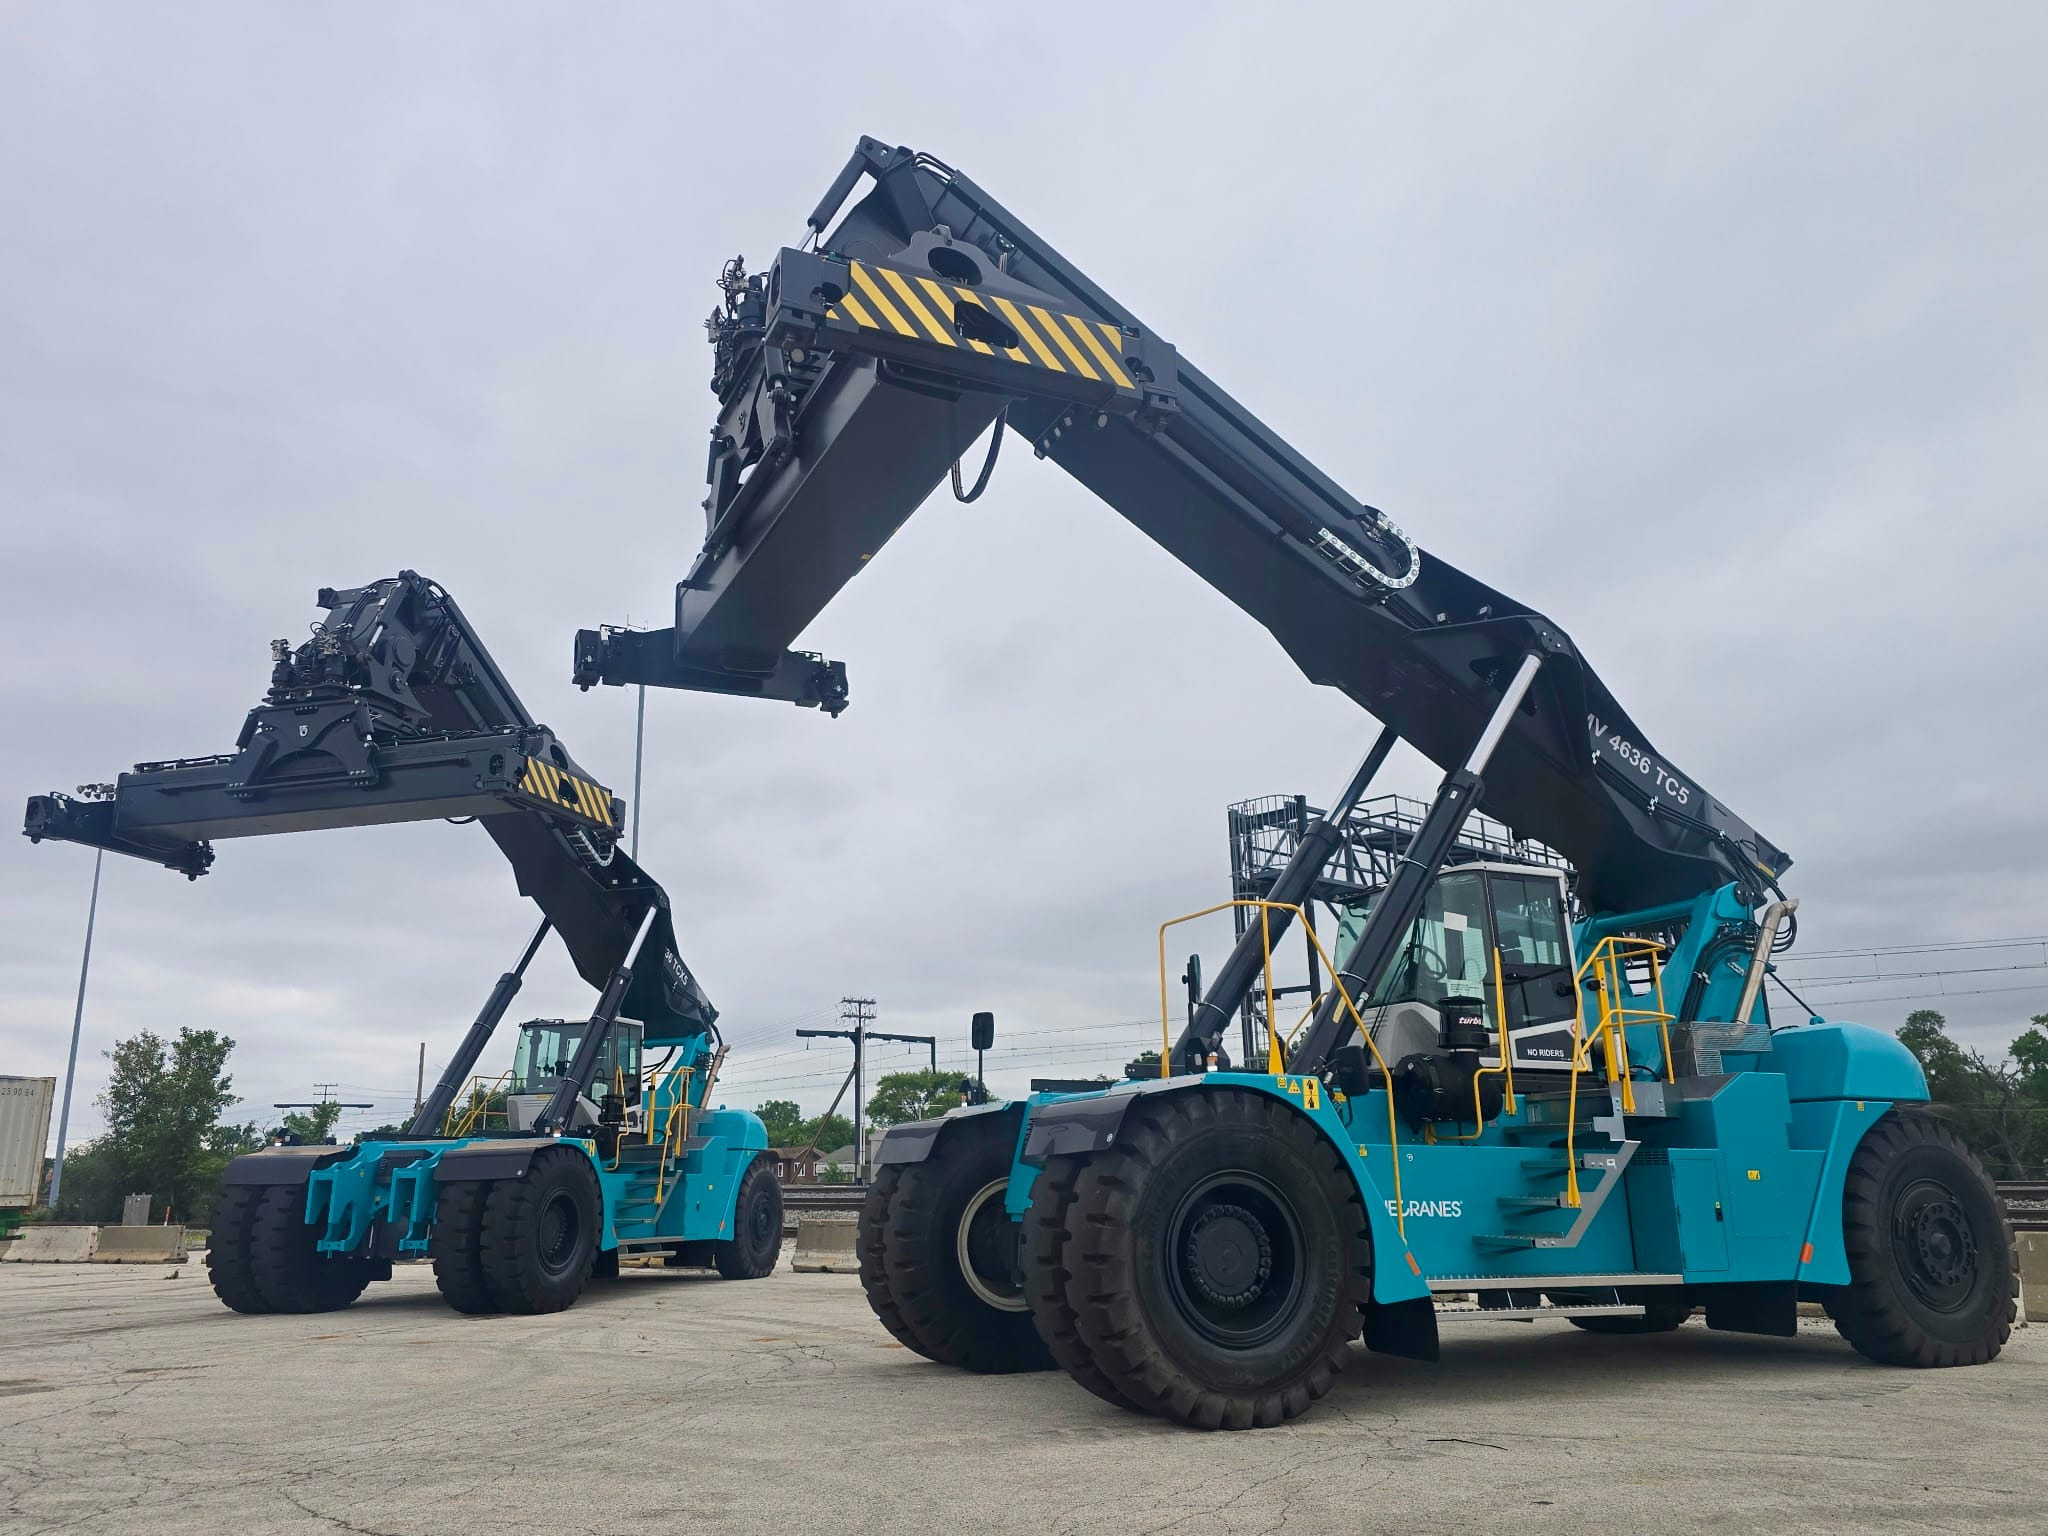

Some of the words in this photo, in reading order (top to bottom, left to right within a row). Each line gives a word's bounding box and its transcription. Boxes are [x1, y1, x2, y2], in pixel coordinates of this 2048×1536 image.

[1609, 735, 1651, 774] 4636
[1655, 766, 1690, 805] TC5
[1527, 1048, 1538, 1056] NO
[1539, 1049, 1565, 1058] RIDERS
